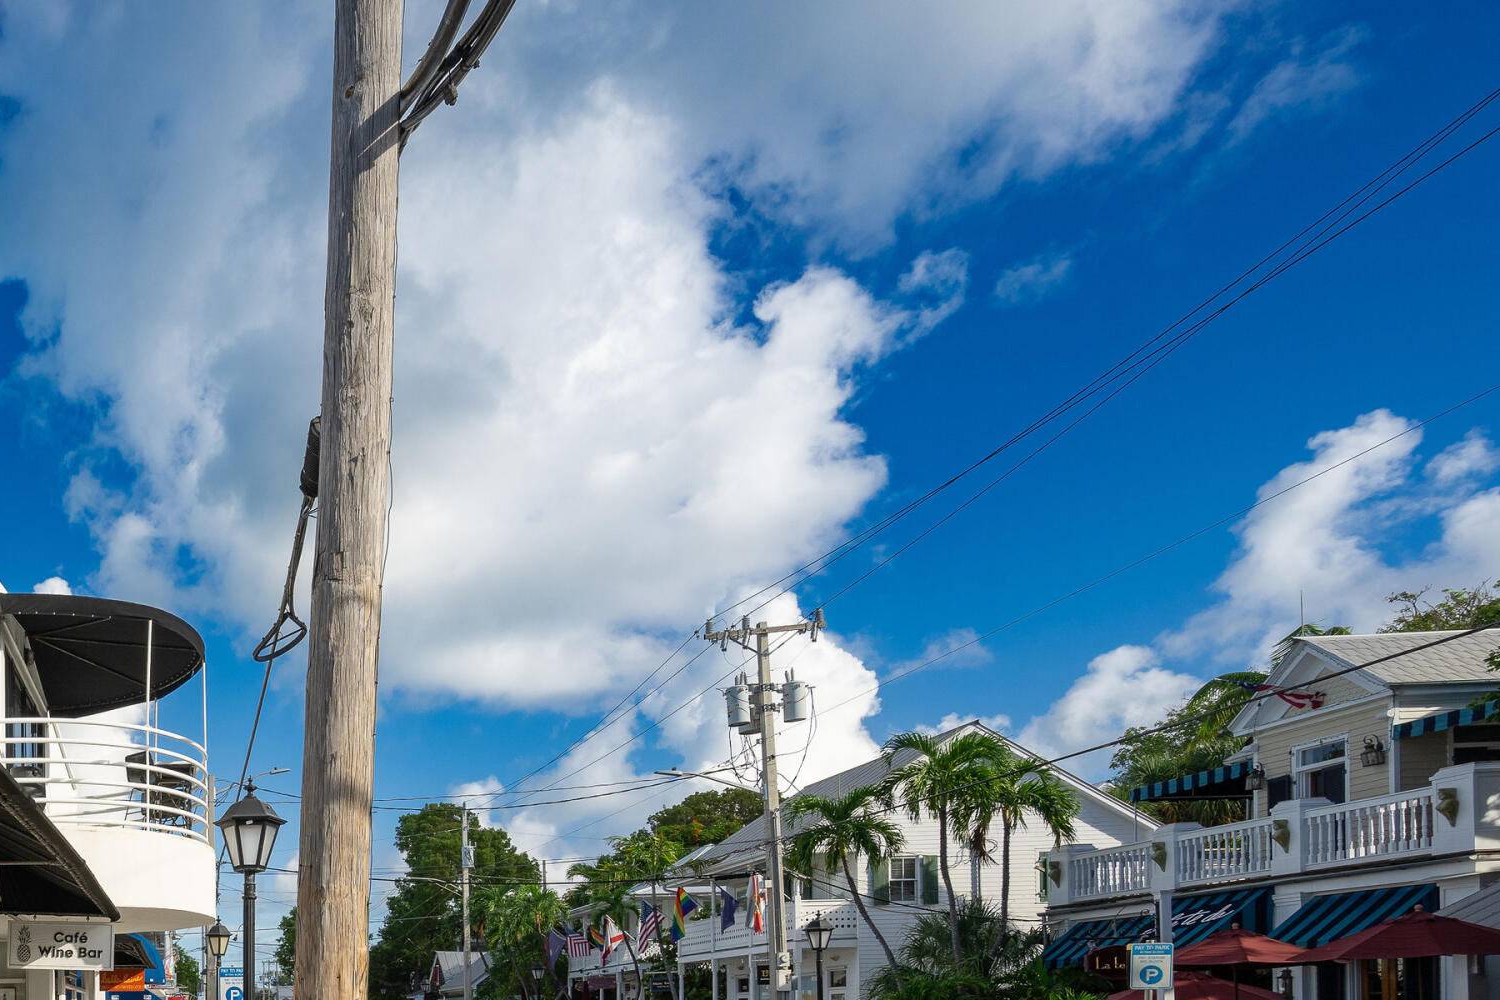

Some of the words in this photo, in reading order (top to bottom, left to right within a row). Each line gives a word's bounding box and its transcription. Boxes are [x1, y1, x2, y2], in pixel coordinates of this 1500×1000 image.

[53, 931, 88, 944] Café
[38, 945, 74, 959] Wine
[77, 947, 103, 959] Bar
[1145, 968, 1159, 981] P
[230, 989, 240, 1000] P
